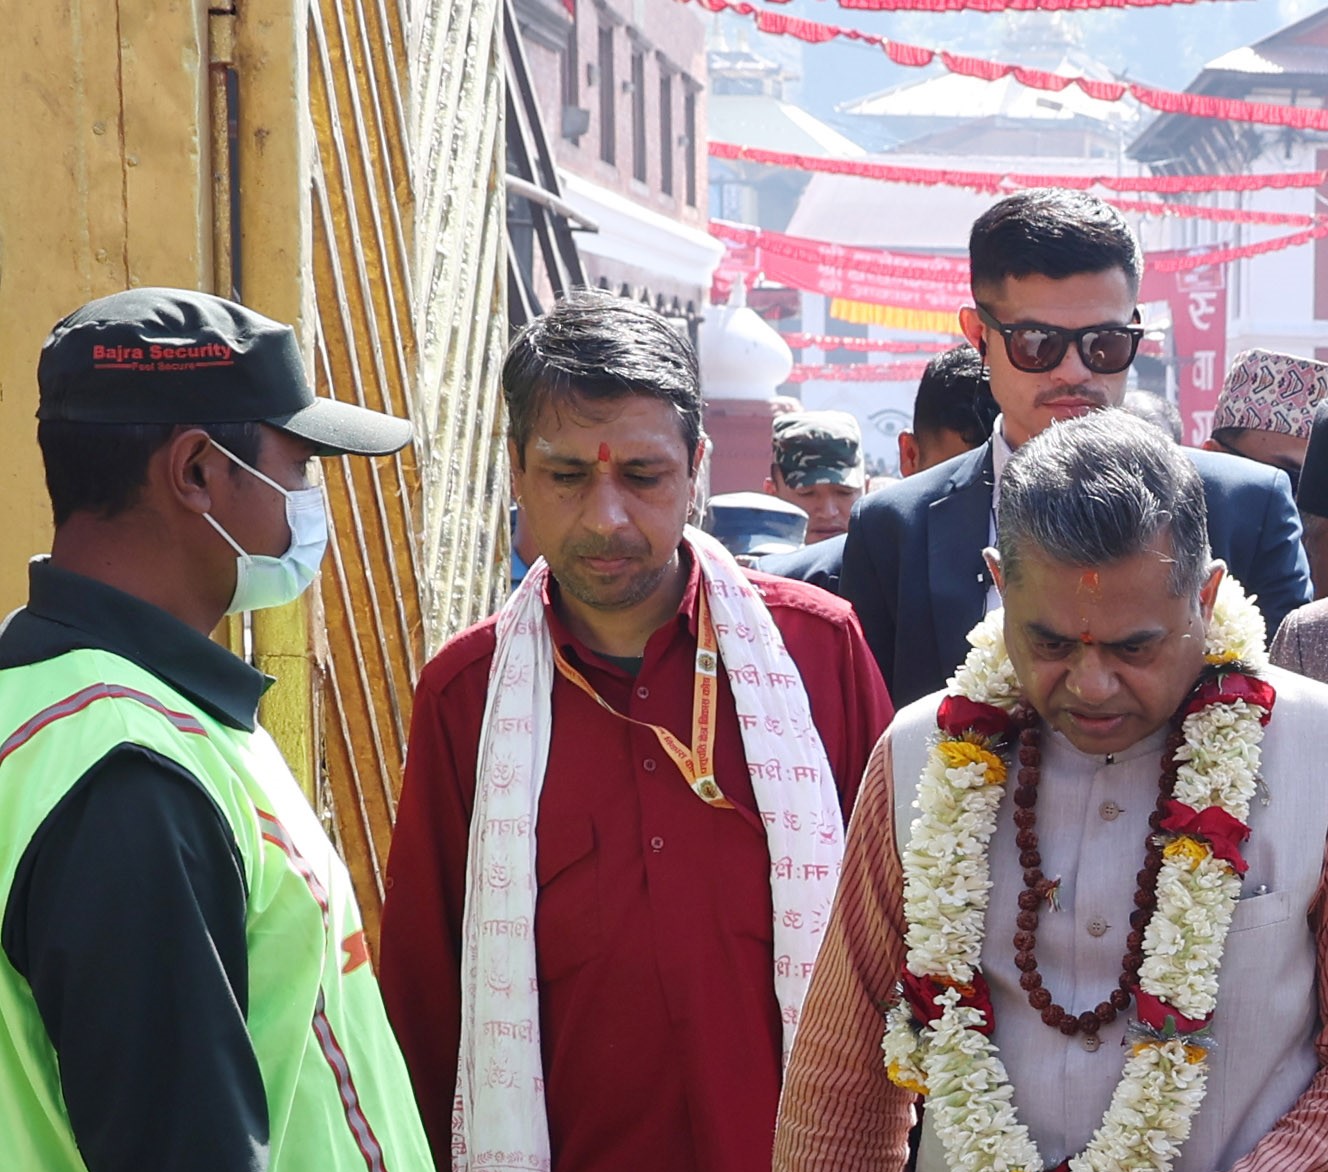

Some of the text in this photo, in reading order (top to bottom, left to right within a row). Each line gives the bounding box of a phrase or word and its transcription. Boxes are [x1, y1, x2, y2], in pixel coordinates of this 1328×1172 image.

[93, 342, 232, 362] Bajra Security
[157, 361, 197, 371] Secure
